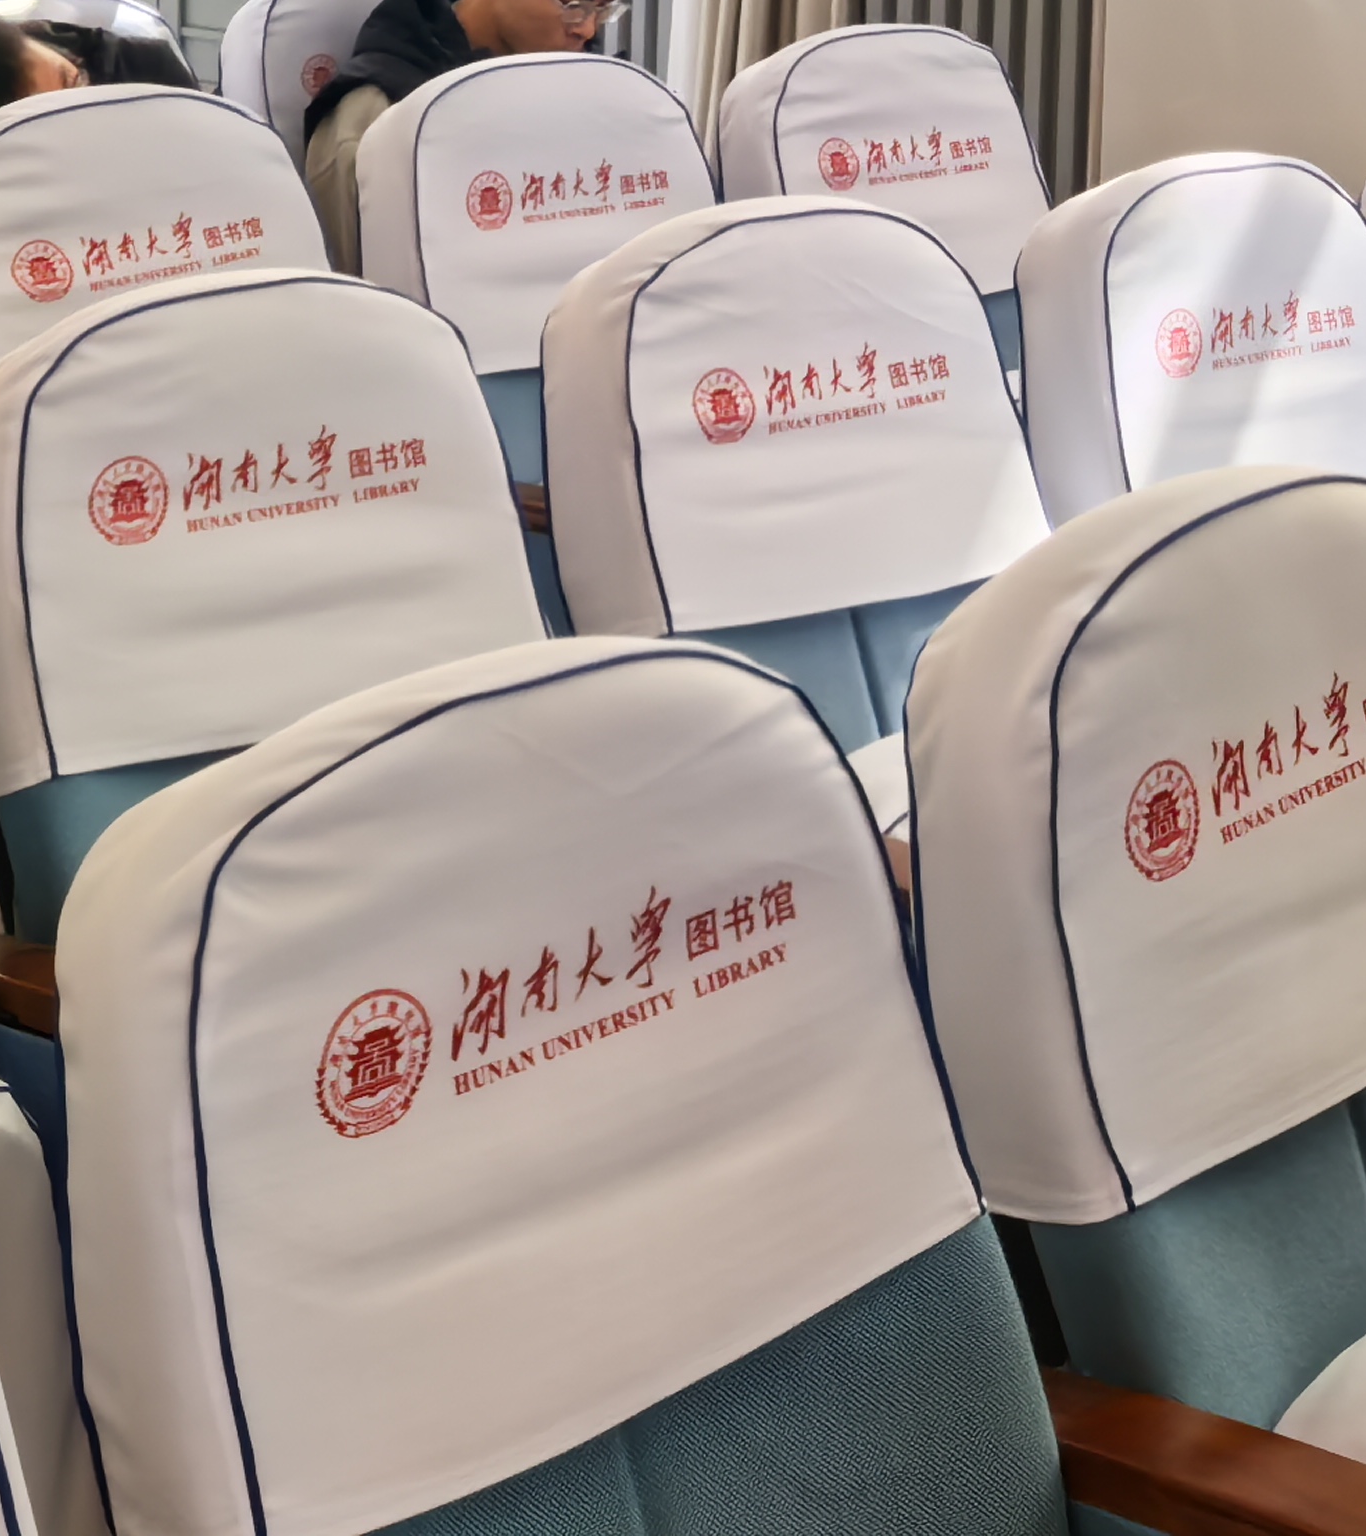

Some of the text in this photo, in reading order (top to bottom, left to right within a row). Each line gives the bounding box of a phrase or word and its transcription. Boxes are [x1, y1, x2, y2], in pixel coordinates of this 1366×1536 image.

[202, 217, 264, 249] 图书馆
[135, 260, 203, 284] UNIVERSITY
[212, 245, 261, 267] LIBRARY
[1307, 305, 1355, 334] 图书馆
[887, 353, 950, 389] 图书馆
[1212, 337, 1351, 371] HUNAN UNIVERSITY LIBRARY
[768, 389, 947, 435] HUNAN UNIVERSITY LIBRARY
[348, 437, 427, 479] 图书馆
[186, 478, 420, 533] HUNAN UNIVERSITY LIBRARY
[1220, 803, 1275, 844] HUNAN
[1278, 758, 1366, 815] UNIVERSITY
[685, 880, 796, 960] 图书馆
[453, 943, 788, 1095] HUNAN UNIVERSITY LIBRARY
